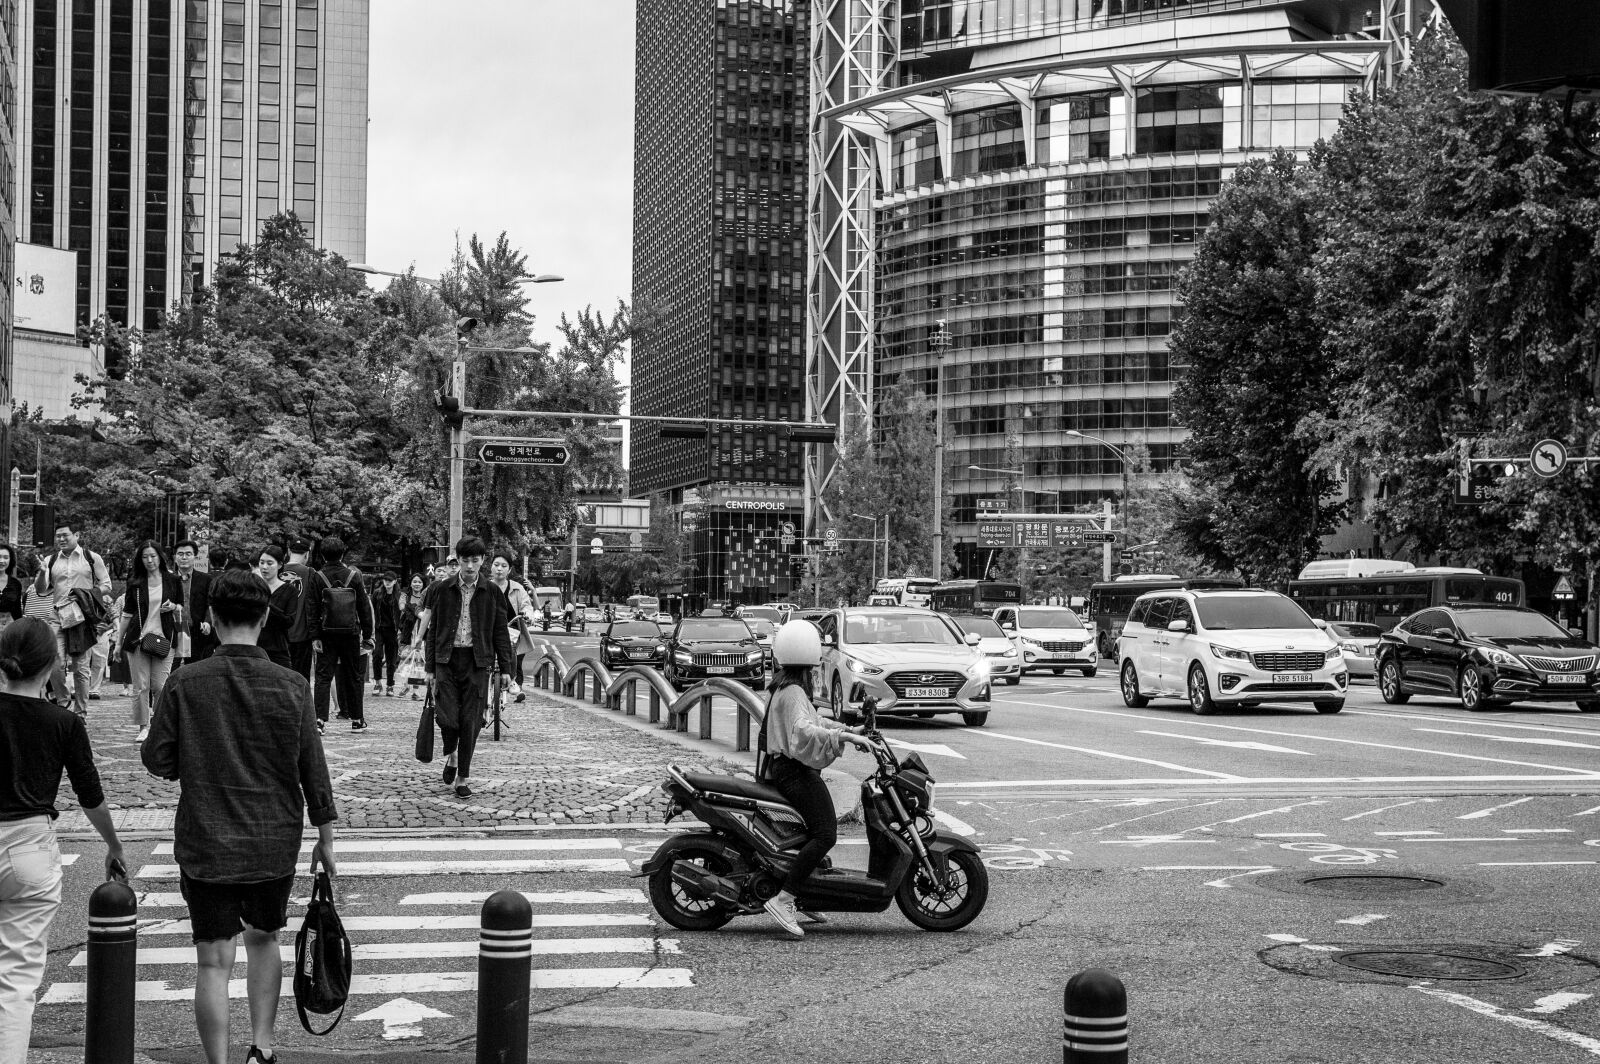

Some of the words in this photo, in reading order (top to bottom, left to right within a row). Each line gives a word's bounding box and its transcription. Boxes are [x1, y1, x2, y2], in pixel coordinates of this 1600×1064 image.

[485, 449, 493, 457] 45
[508, 446, 541, 456] 청계천로
[725, 500, 785, 511] CENTROPOLIS
[1004, 590, 1016, 598] 704
[1495, 592, 1512, 602] 401
[928, 688, 947, 697] 8308
